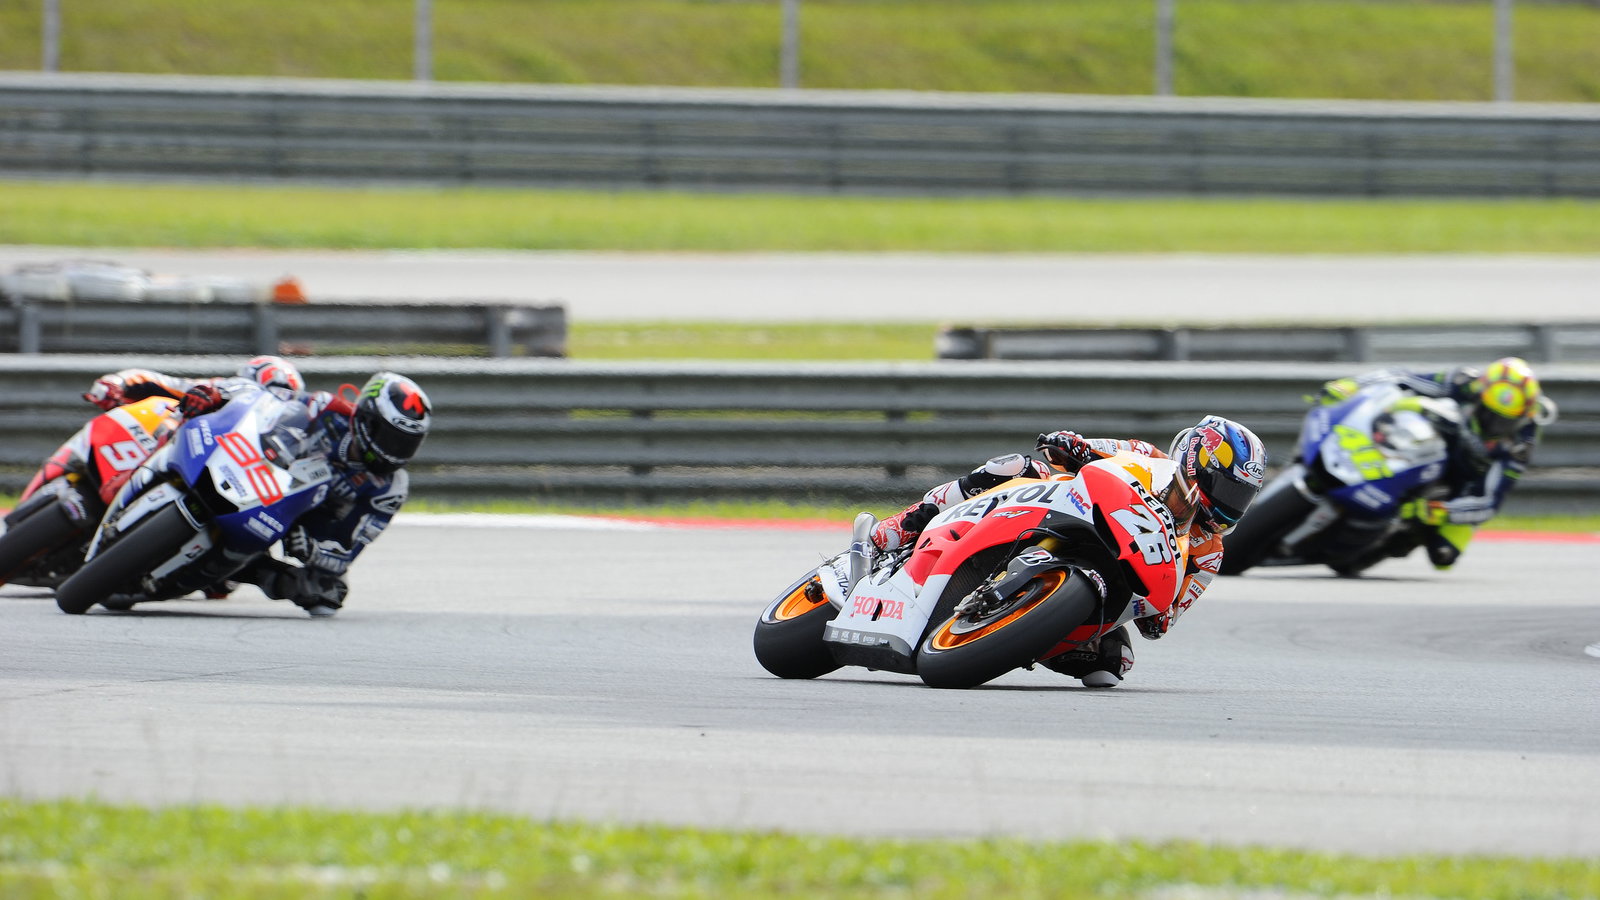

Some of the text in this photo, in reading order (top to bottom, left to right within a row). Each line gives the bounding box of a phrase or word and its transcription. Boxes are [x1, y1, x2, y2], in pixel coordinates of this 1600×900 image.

[214, 432, 285, 507] 99
[1109, 504, 1173, 566] 26
[1130, 480, 1181, 565] REPSOL
